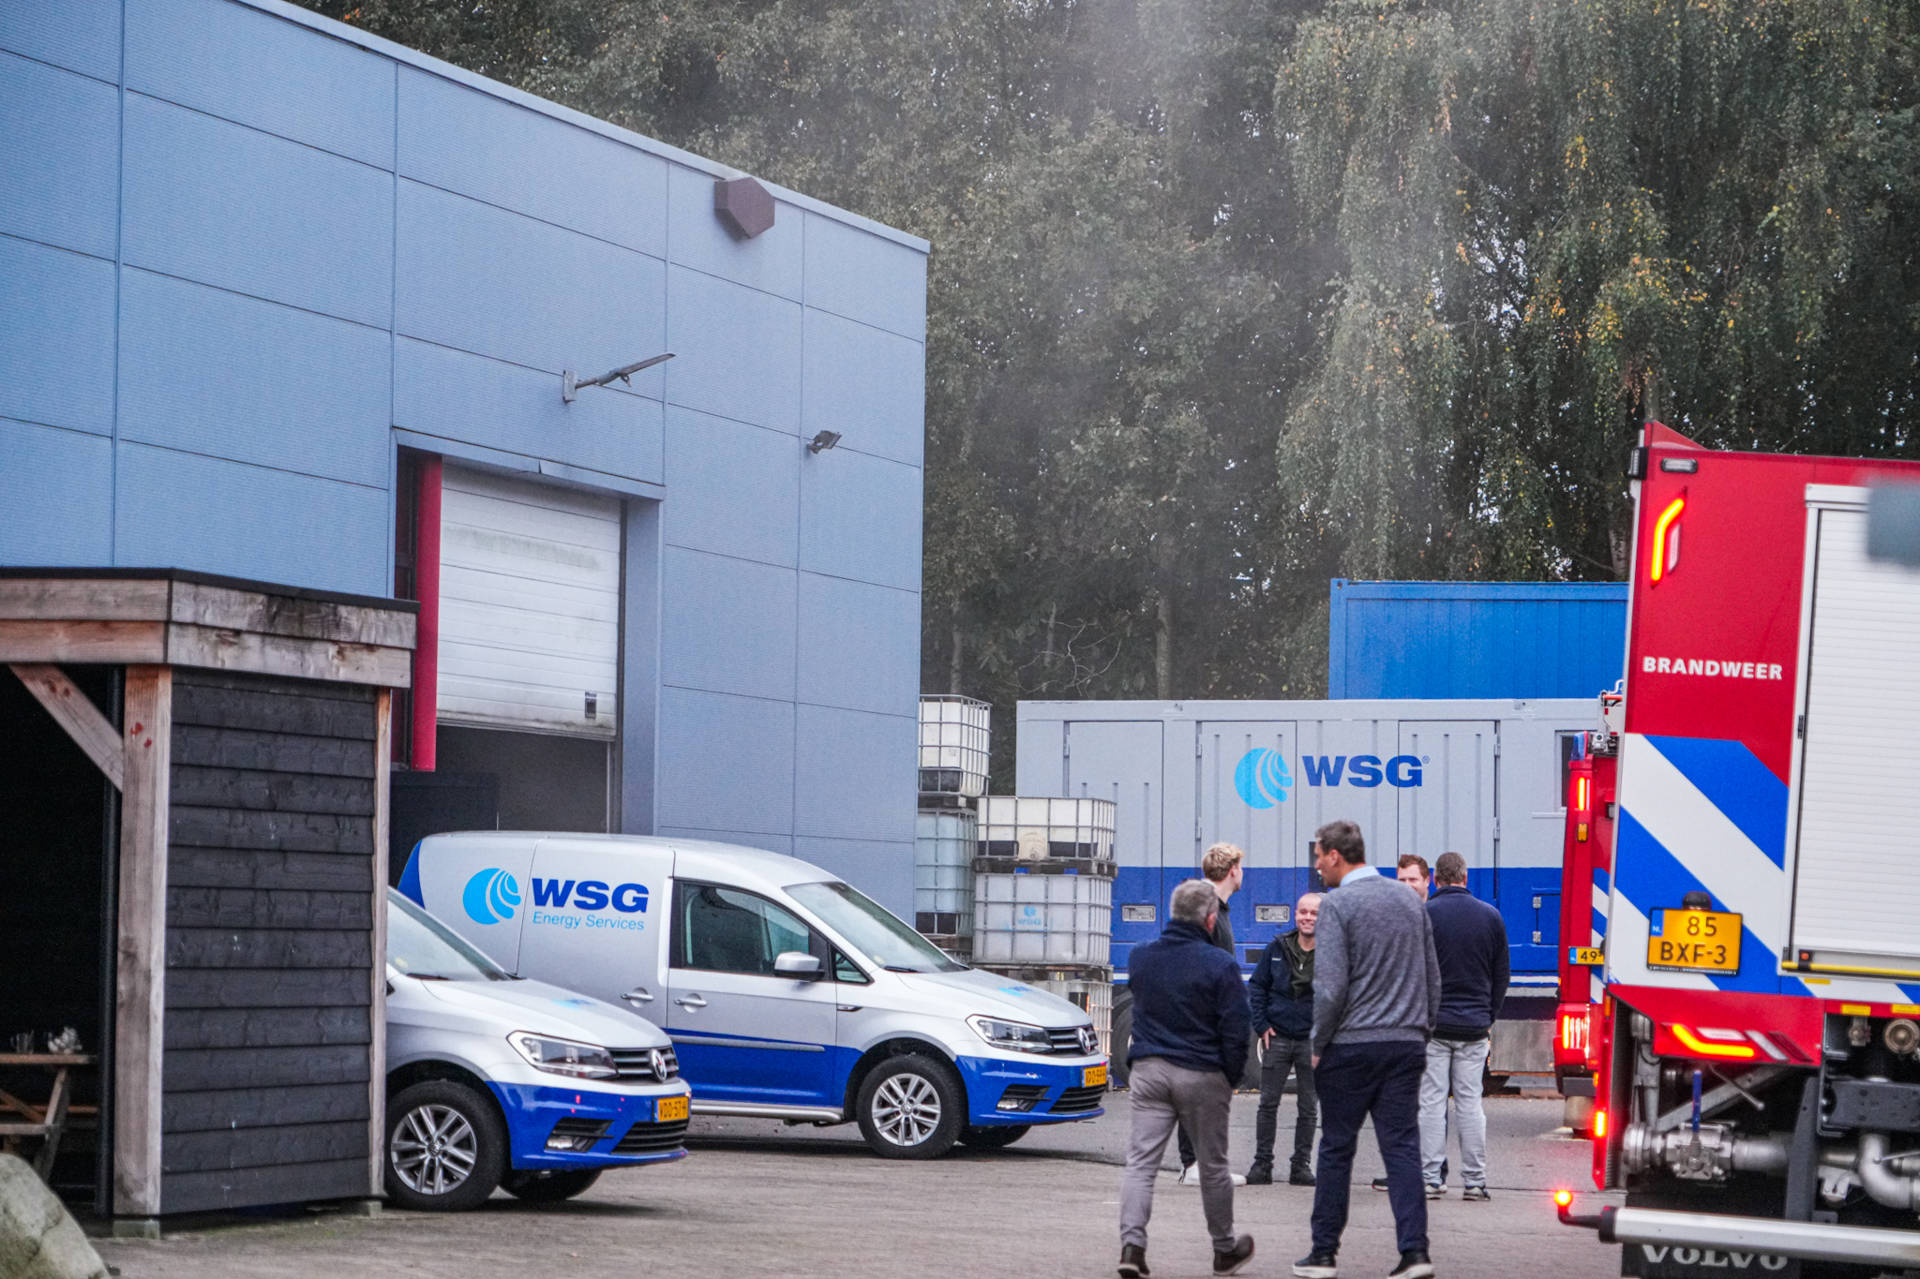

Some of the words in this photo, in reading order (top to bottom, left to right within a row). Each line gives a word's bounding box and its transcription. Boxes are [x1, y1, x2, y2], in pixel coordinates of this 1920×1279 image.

[1643, 656, 1783, 680] BRANDWEER
[532, 878, 650, 913] WSG
[532, 911, 581, 930] Energy
[585, 914, 645, 931] Services
[1687, 915, 1717, 937] 85
[1580, 950, 1602, 962] 49
[1660, 941, 1727, 965] BXF-3
[1641, 1244, 1789, 1271] VOLVO
